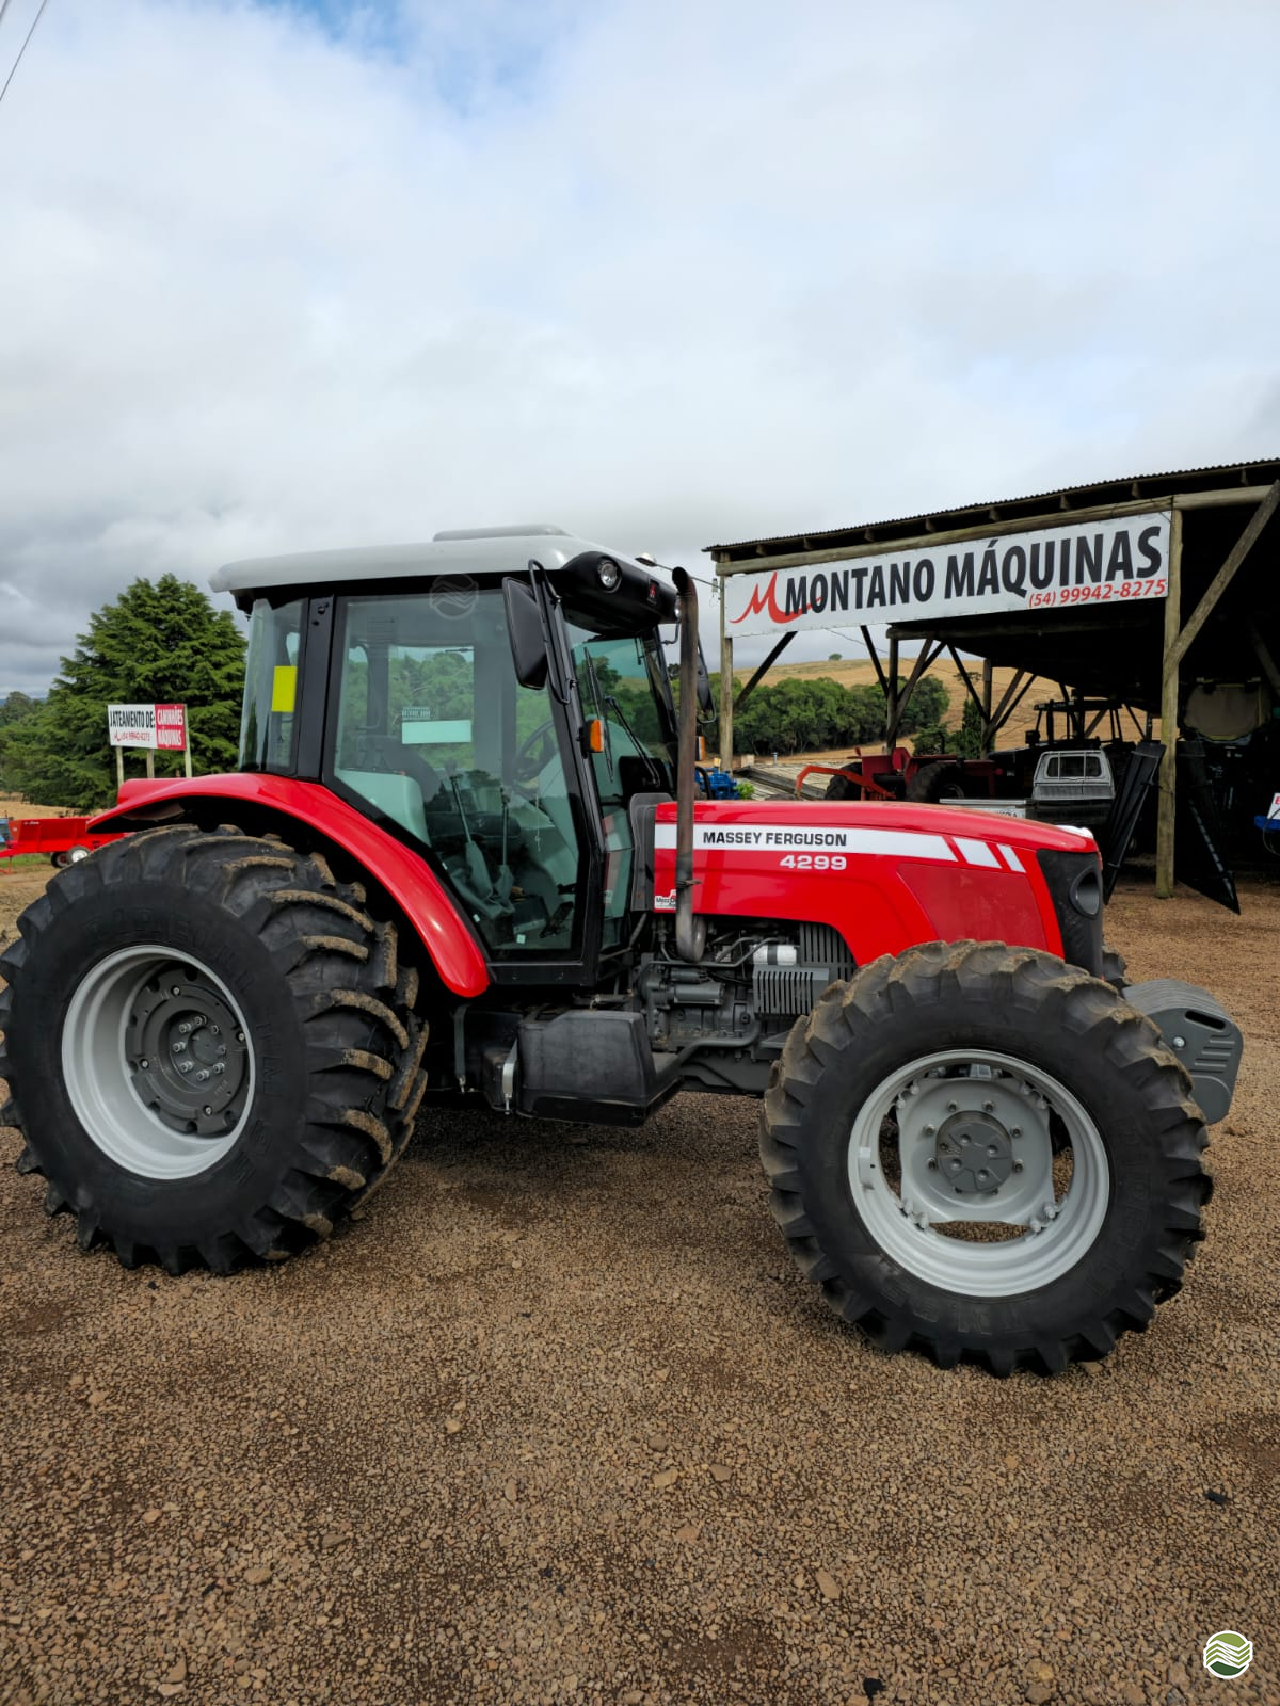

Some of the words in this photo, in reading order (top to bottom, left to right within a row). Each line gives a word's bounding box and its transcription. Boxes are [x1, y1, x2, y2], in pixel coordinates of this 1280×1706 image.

[785, 559, 935, 616] MONTANO
[944, 526, 1162, 599] MÁQUINAS
[1028, 591, 1057, 608] (54)
[1060, 578, 1167, 604] 99942-8275
[109, 710, 145, 728] JATEAMENTO
[703, 832, 762, 844] MASSEY
[766, 833, 847, 847] FERGUSON
[780, 854, 847, 871] 4299
